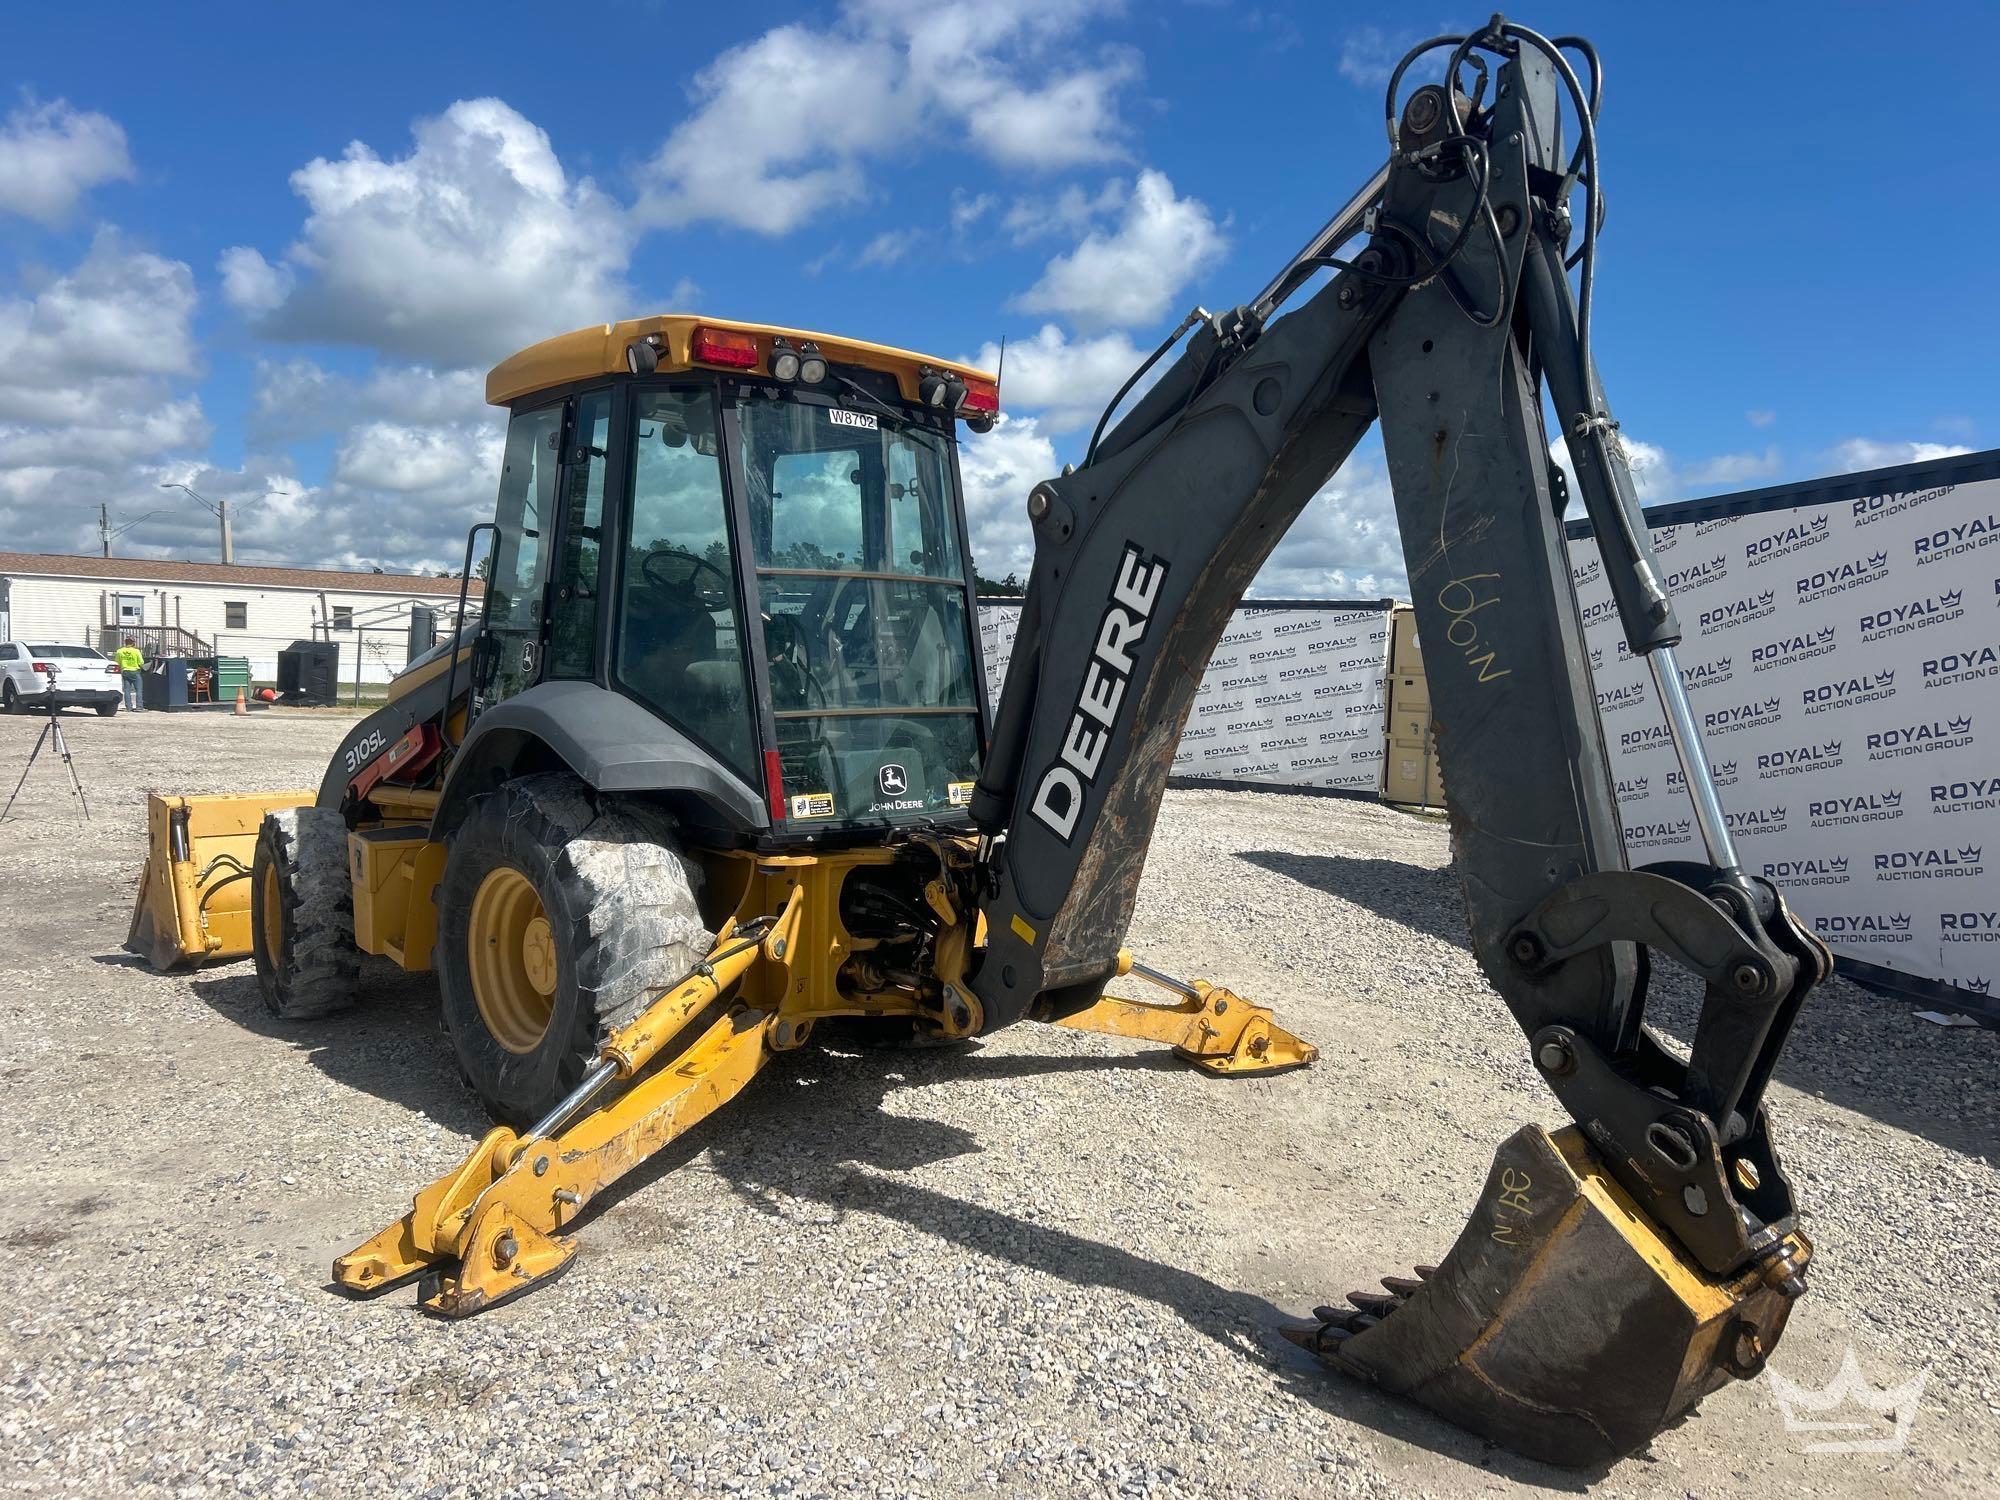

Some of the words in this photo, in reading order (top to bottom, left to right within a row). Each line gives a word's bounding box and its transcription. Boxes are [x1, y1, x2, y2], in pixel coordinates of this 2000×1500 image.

[832, 410, 874, 427] W8702
[1854, 502, 1907, 528] AUCTION
[1910, 485, 1955, 508] GROUP
[1746, 524, 1810, 558] ROYAL
[1914, 515, 2000, 554] ROYAL
[1748, 546, 1790, 568] AUCTION
[1793, 532, 1830, 551] GROUP
[1916, 540, 1976, 566] AUCTION
[1670, 584, 1695, 597] CTION
[1696, 570, 1728, 588] GROUP
[1796, 560, 1867, 594] ROYAL
[1798, 582, 1846, 605] AUCTION
[1848, 570, 1888, 589] GROUP
[1334, 611, 1372, 622] ROYAL
[1582, 598, 1618, 620] ROYA
[1700, 598, 1758, 626] ROYAL
[1860, 598, 1939, 632] ROYAL
[1274, 622, 1311, 633] ROYAL
[1584, 613, 1614, 628] AUCTION
[1701, 616, 1740, 636] AUCTION
[1742, 606, 1776, 623] GROUP
[1862, 622, 1915, 644] AUCTION
[1918, 609, 1964, 628] GROUP
[1308, 639, 1346, 650] ROYAL
[1752, 634, 1816, 662] ROYAL
[1250, 649, 1286, 660] ROYAL
[1340, 657, 1378, 668] ROYAL
[1754, 655, 1796, 672] AUCTION
[1798, 644, 1836, 660] GROUP
[1923, 645, 2000, 677] ROYA
[1280, 667, 1317, 678] ROYAL
[1702, 673, 1732, 688] GROUP
[1925, 668, 1985, 689] AUCTION
[1222, 676, 1257, 687] ROYAL
[1314, 684, 1352, 695] ROYAL
[1803, 676, 1874, 704] ROYAL
[1031, 549, 1164, 840] DEERE
[1255, 694, 1292, 704] ROYAL
[1598, 687, 1631, 705] OYAL
[1618, 696, 1644, 709] GROUP
[1804, 699, 1852, 716] AUCTION
[1855, 689, 1896, 704] GROUP
[1199, 702, 1234, 713] ROYAL
[1705, 702, 1763, 728] ROYAL
[1228, 720, 1263, 730] ROYAL
[1285, 712, 1322, 722] ROYAL
[1706, 722, 1746, 737] AUCTION
[1748, 714, 1781, 728] GROUP
[1182, 728, 1206, 737] OYAL
[1320, 730, 1358, 740] ROYAL
[1867, 722, 1948, 750] ROYAL
[345, 729, 387, 773] 310SL
[1204, 746, 1238, 756] ROYAL
[1260, 738, 1298, 748] ROYAL
[1622, 740, 1656, 755] AUCTION
[1868, 745, 1922, 762] AUCTION
[1926, 736, 1974, 753] GROUP
[1291, 757, 1328, 767] ROYAL
[1351, 750, 1383, 759] ROYA
[1758, 745, 1822, 770] ROYAL
[1233, 764, 1268, 774] ROYAL
[1759, 766, 1802, 780] AUCTION
[1805, 759, 1842, 772] GROUP
[1326, 776, 1364, 785] ROYAL
[1622, 792, 1649, 802] GROUP
[1930, 778, 2000, 802] ROYA
[869, 802, 894, 812] JOHN
[896, 800, 923, 809] DEERE
[1810, 794, 1881, 817] ROYAL
[1933, 799, 1996, 814] AUCTION
[1725, 810, 1769, 827] OYAL
[1810, 816, 1859, 828] AUCTION
[1862, 810, 1904, 822] GROUP
[1625, 823, 1676, 840] ROYAL
[1753, 824, 1787, 834] GROUP
[1662, 836, 1691, 846] GROUP
[1874, 849, 1957, 870] ROYAL
[1763, 859, 1829, 878] ROYAL
[1876, 870, 1932, 882] AUCTION
[1935, 867, 1983, 878] GROUP
[1812, 876, 1850, 886] GROUP
[1815, 916, 1890, 932] ROYAL
[1870, 934, 1912, 942] GROUP
